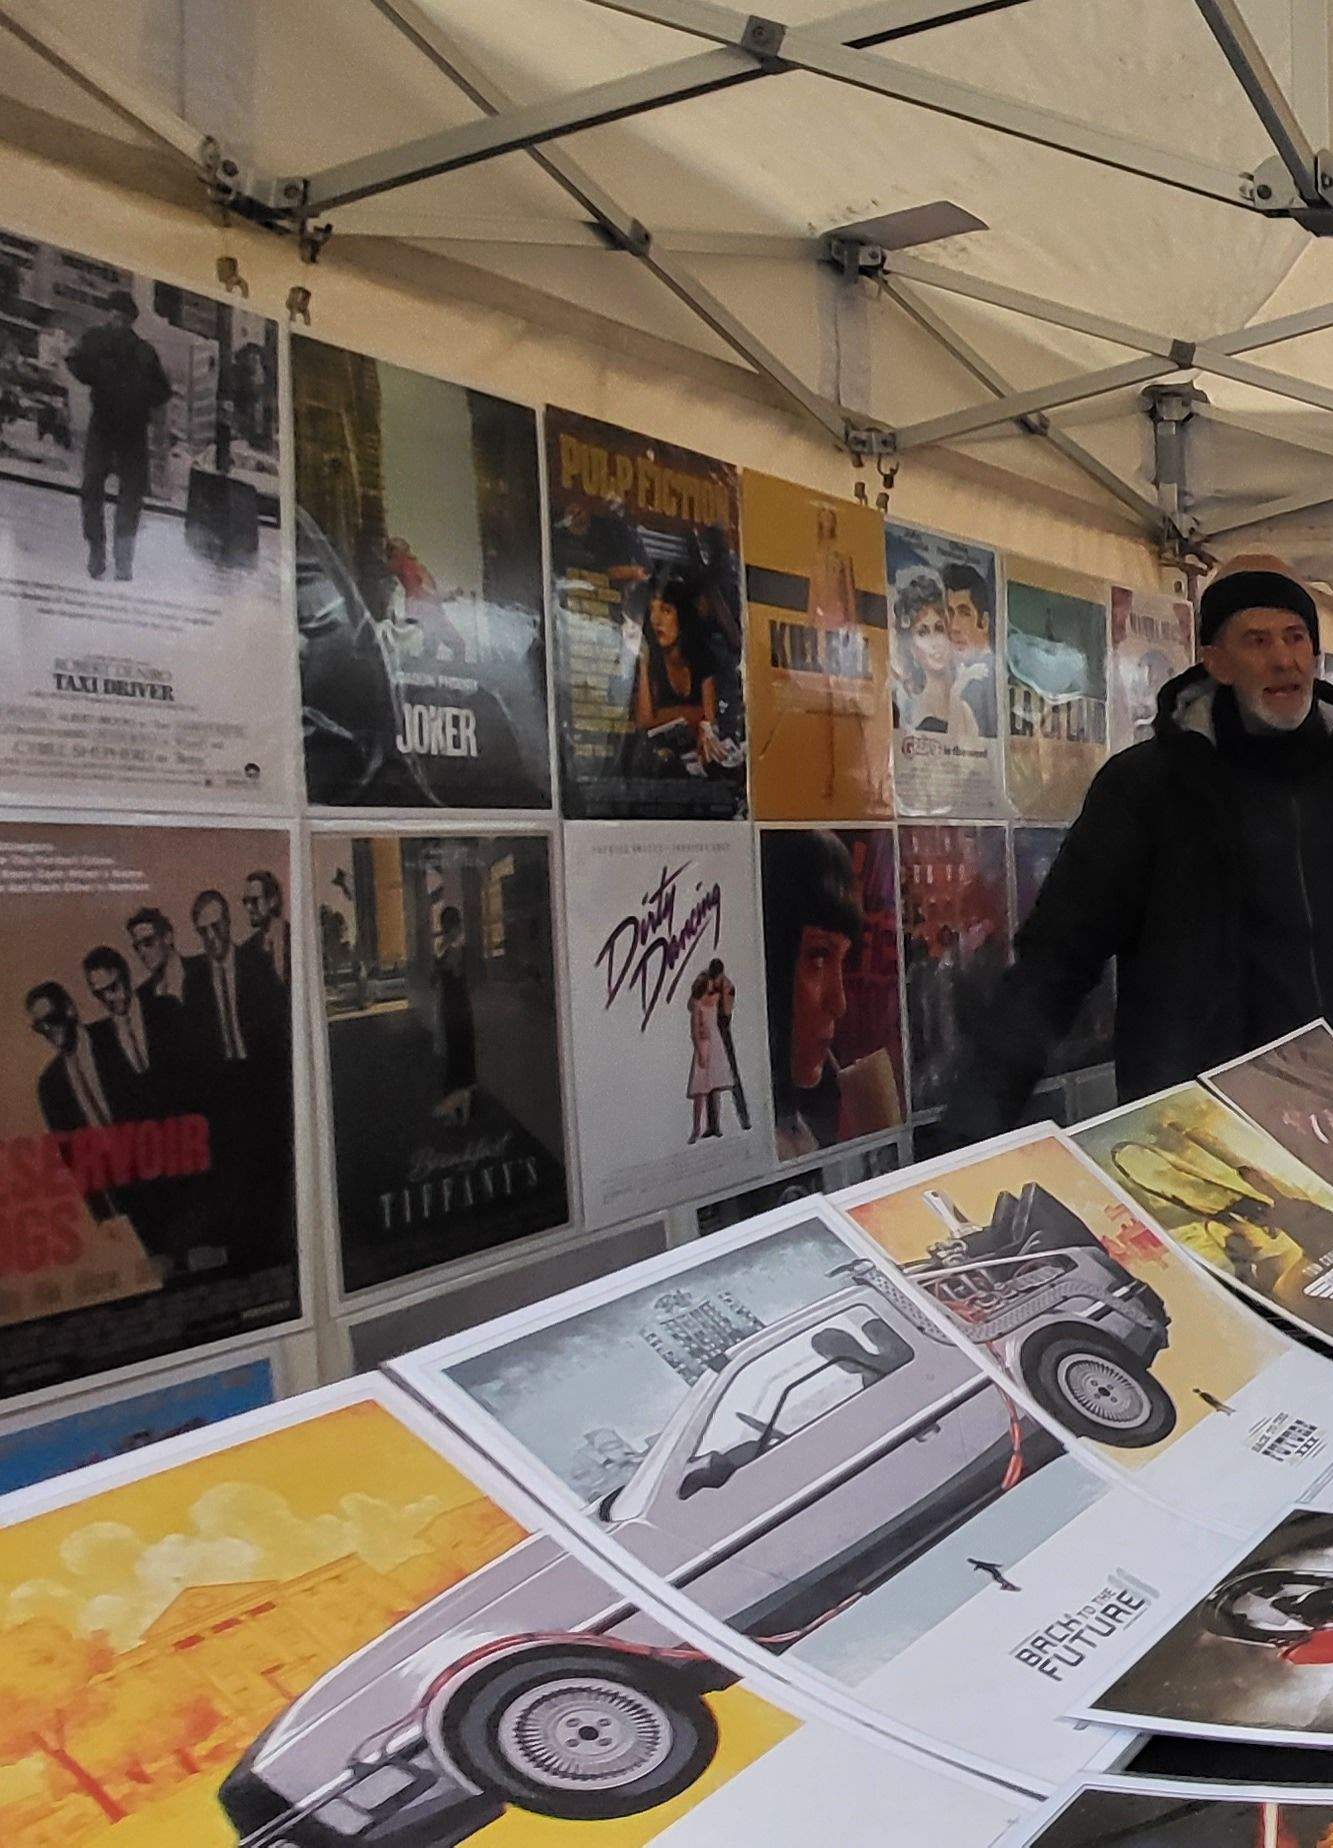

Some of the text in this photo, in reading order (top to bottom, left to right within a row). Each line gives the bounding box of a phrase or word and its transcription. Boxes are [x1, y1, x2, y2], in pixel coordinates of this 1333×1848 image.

[560, 433, 635, 499] PULP
[53, 673, 99, 694] TAXI
[103, 680, 175, 702] DRIVER
[396, 702, 479, 758] JOKER
[594, 860, 694, 1011] Dirty
[628, 880, 722, 1034] Dancing
[1014, 1587, 1117, 1668] BACK TO THE
[1037, 1589, 1146, 1682] FUTURE
